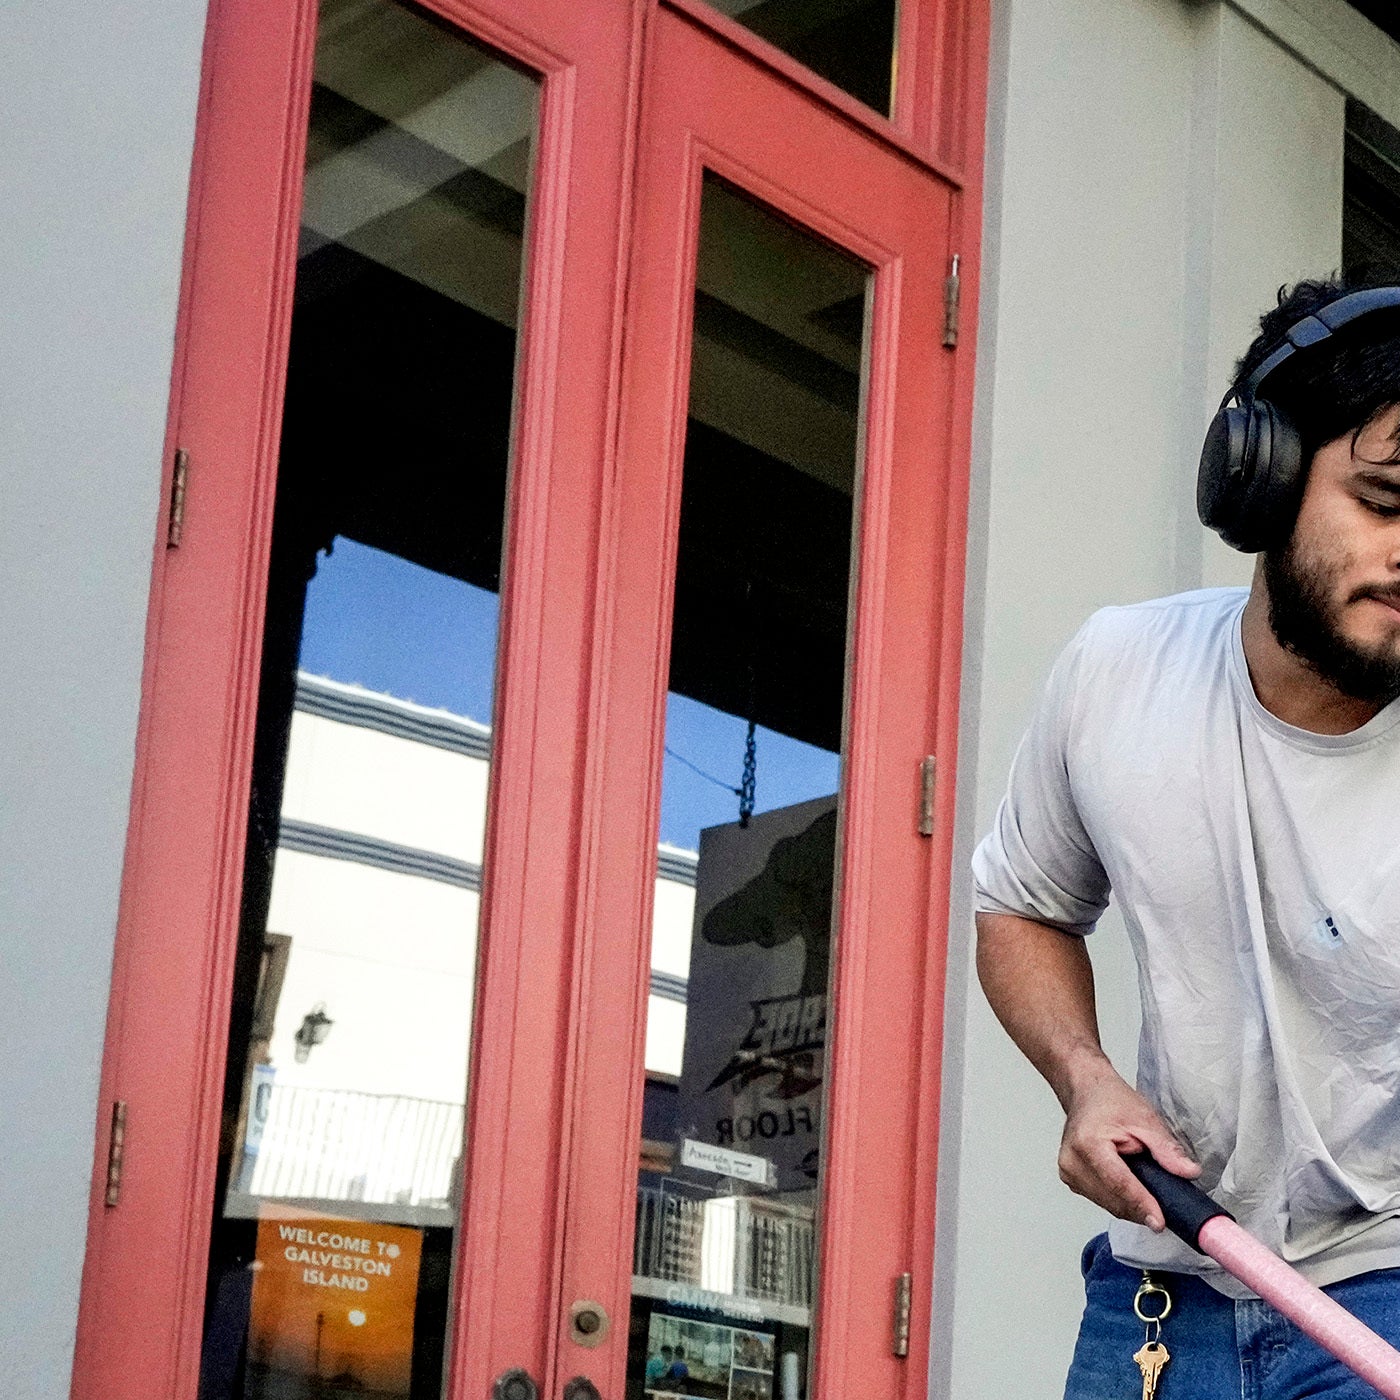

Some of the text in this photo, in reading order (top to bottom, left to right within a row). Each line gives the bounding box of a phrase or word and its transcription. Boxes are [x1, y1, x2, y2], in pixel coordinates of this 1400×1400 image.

[278, 1225, 372, 1255] WELCOME
[284, 1245, 392, 1277] GALVESTON
[302, 1268, 370, 1292] ISLAND
